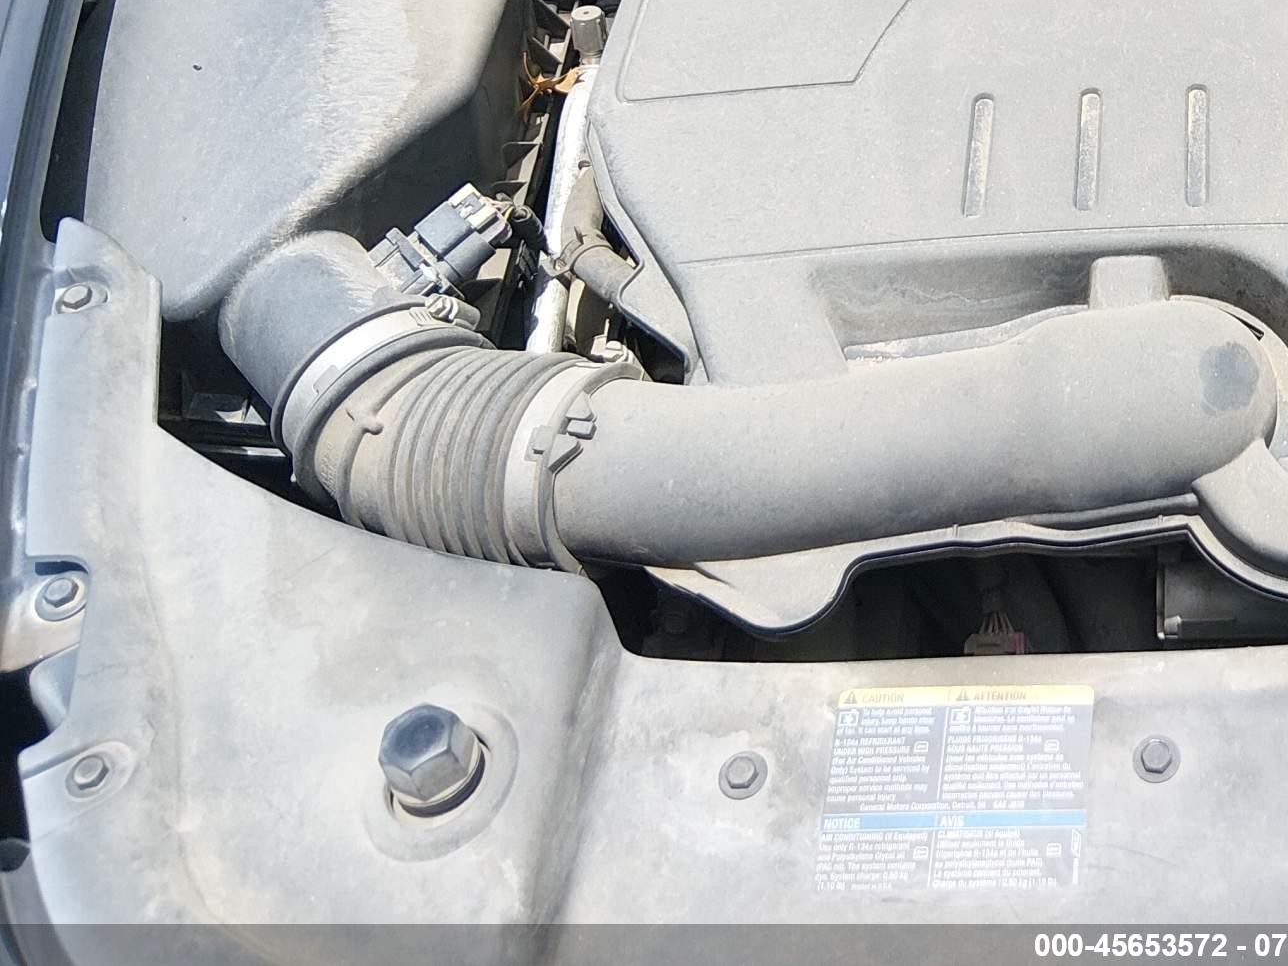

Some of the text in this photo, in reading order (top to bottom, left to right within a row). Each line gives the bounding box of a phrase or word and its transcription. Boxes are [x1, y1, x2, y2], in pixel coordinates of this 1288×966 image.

[863, 692, 905, 703] CAUTION
[973, 690, 1027, 701] ATTENTION
[823, 818, 861, 830] NOTICE
[939, 815, 965, 827] AVIS
